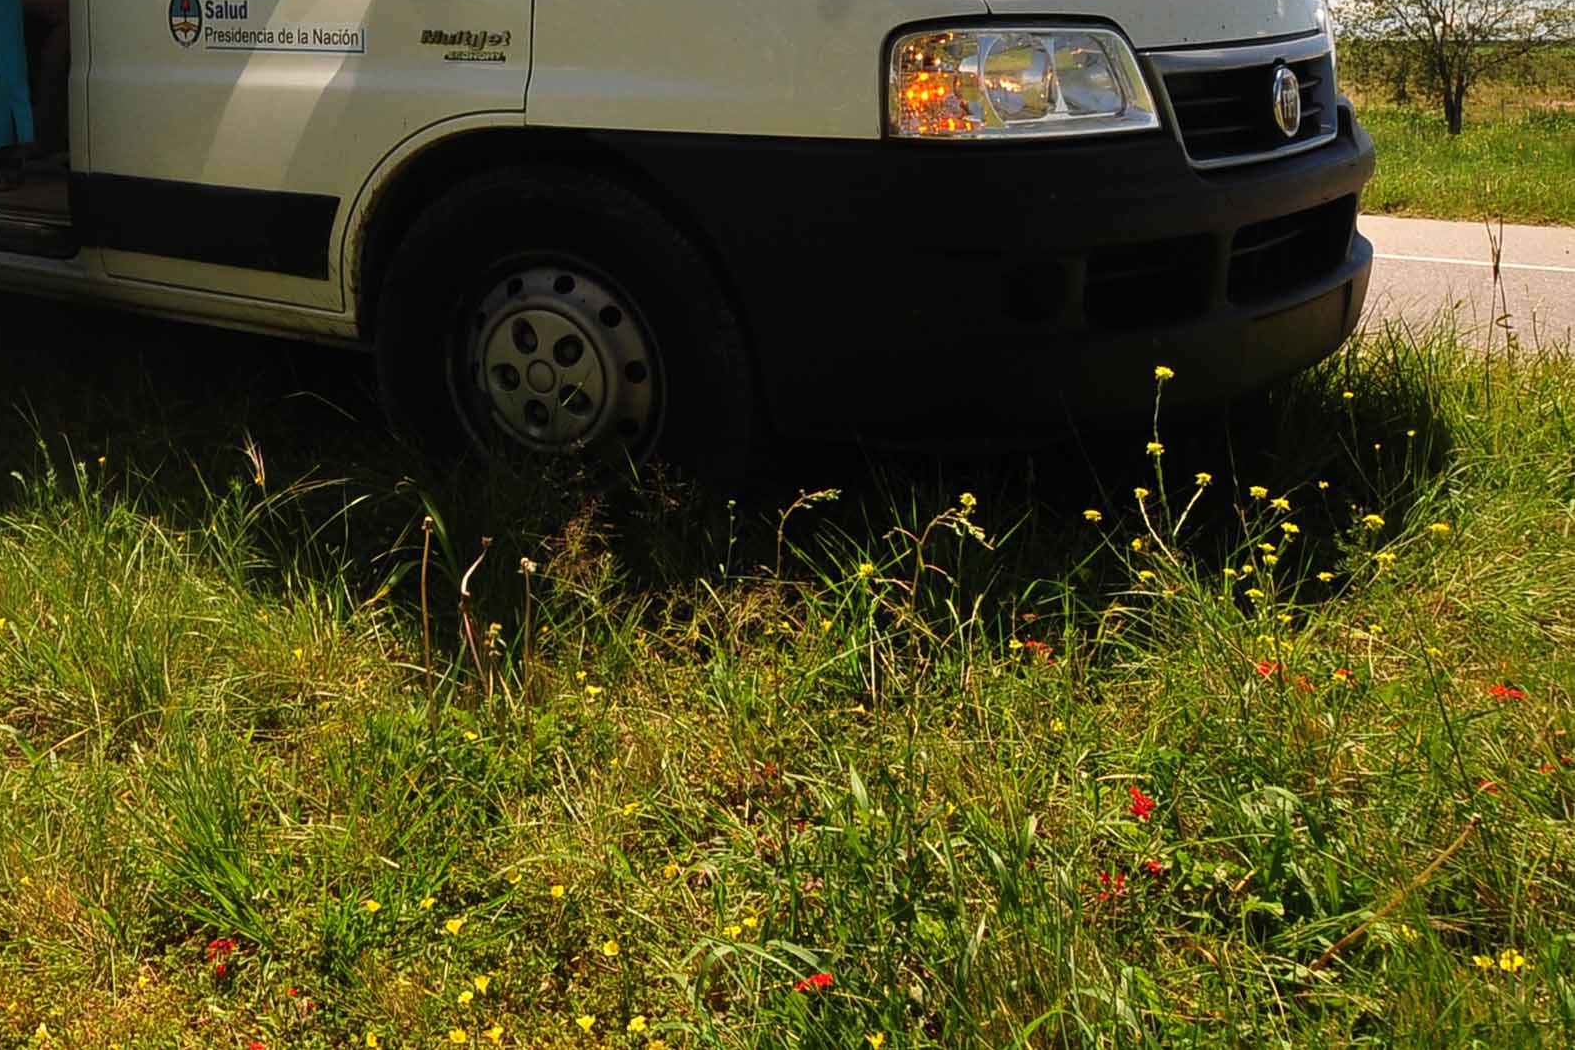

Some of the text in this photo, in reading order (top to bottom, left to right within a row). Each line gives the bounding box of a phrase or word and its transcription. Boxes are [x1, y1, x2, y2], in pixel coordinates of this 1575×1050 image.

[205, 0, 248, 20] Salud
[205, 26, 359, 46] Presidencia de la Nación
